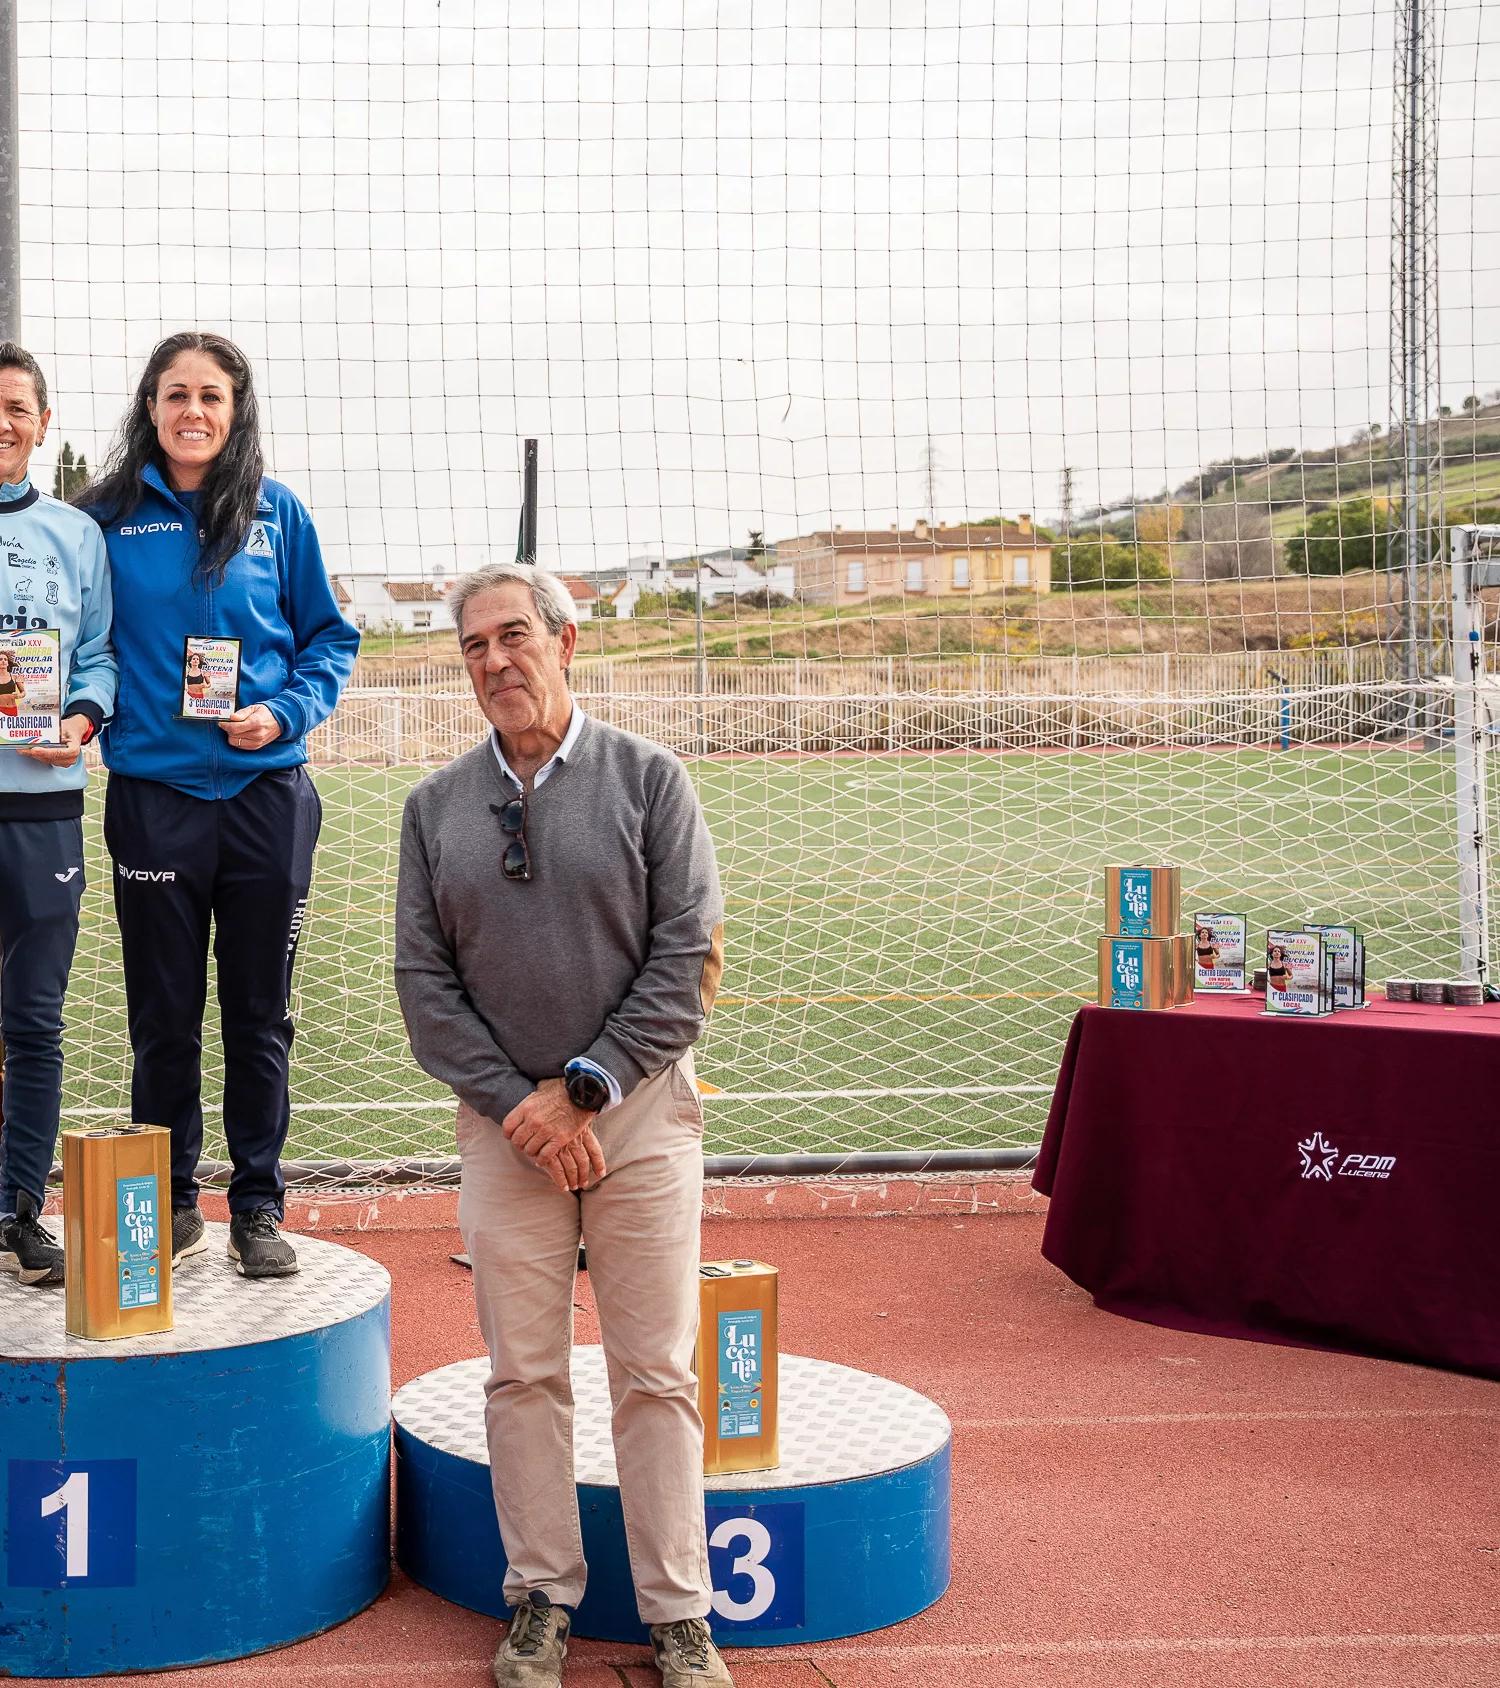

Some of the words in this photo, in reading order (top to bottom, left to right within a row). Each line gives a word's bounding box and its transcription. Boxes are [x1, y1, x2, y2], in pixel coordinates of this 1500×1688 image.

[120, 523, 182, 536] GIVOVA
[16, 647, 52, 656] CARRERA
[12, 667, 53, 675] LUCENA
[196, 699, 230, 709] CLASIFICADA
[7, 716, 52, 729] CLASIFICADA
[119, 863, 175, 882] GIVOVA
[1217, 969, 1241, 977] EDUCATIVO
[1279, 992, 1313, 1003] CLASIFICADO
[1342, 1154, 1396, 1170] PDM
[1338, 1166, 1390, 1179] Lucena
[40, 1472, 89, 1577] 1
[708, 1517, 775, 1622] 3
